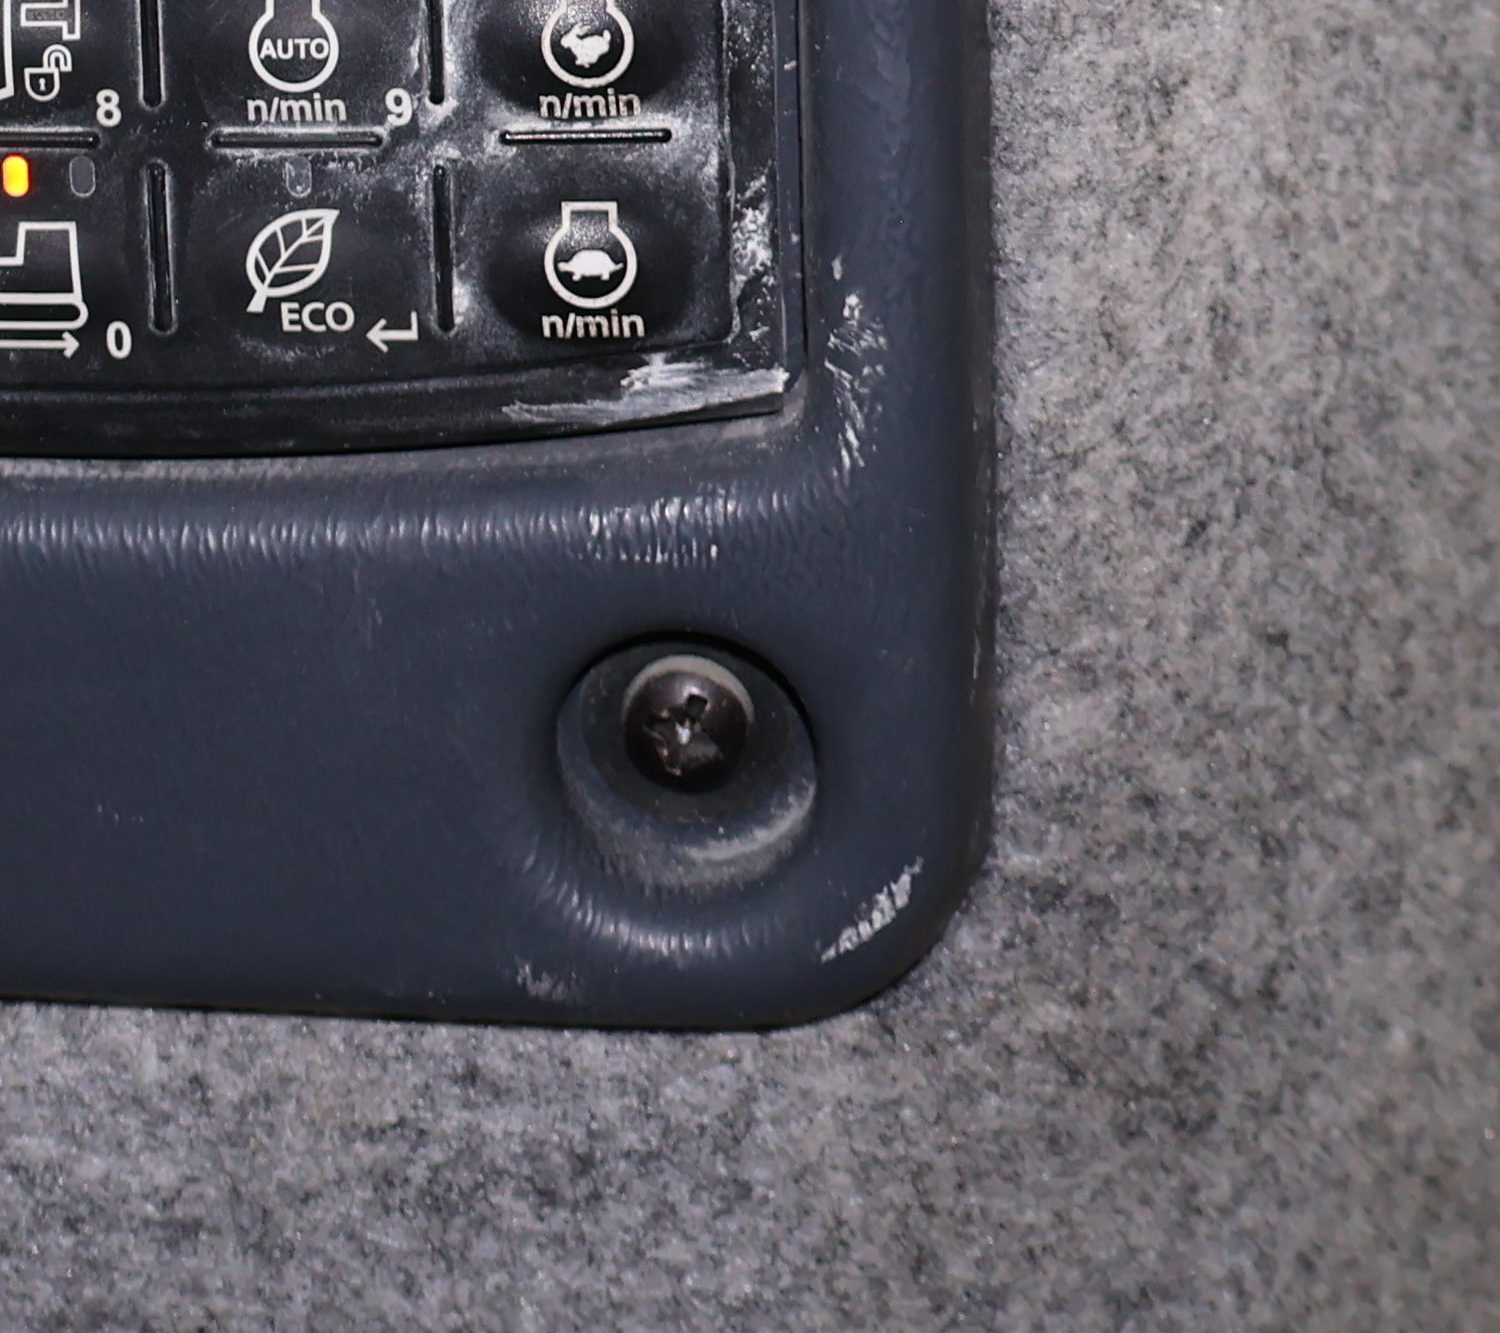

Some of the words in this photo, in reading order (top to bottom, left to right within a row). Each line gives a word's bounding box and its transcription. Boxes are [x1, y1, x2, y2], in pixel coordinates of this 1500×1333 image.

[259, 36, 330, 61] AUTO
[96, 89, 122, 127] 8
[246, 93, 347, 123] n/min
[385, 88, 413, 125] 9
[538, 89, 643, 119] n/min
[280, 301, 355, 332] ECO
[541, 310, 645, 339] n/min
[106, 321, 132, 359] 0
